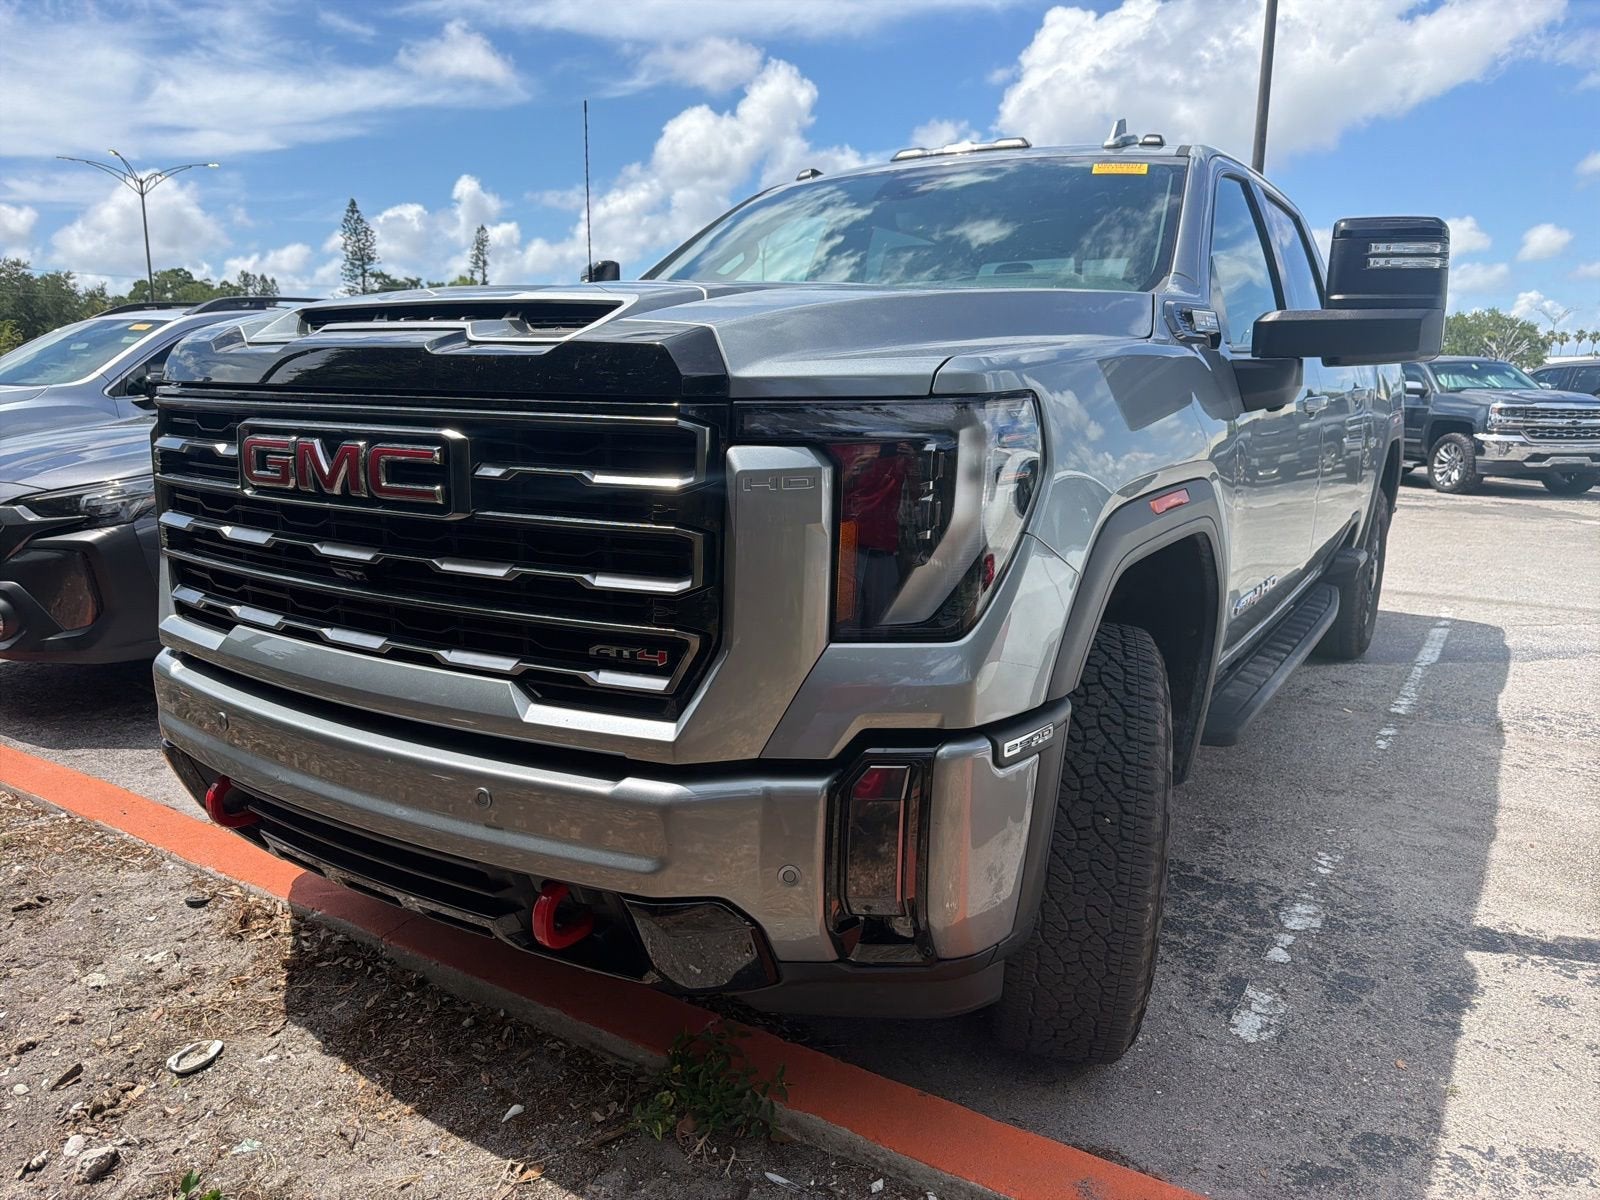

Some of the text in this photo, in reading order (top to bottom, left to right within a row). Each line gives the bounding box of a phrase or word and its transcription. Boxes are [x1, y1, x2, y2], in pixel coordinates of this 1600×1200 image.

[243, 433, 444, 504] GMC
[743, 474, 815, 492] HD
[1261, 575, 1279, 596] HD
[588, 644, 668, 667] AT4
[1006, 726, 1053, 755] 2500
